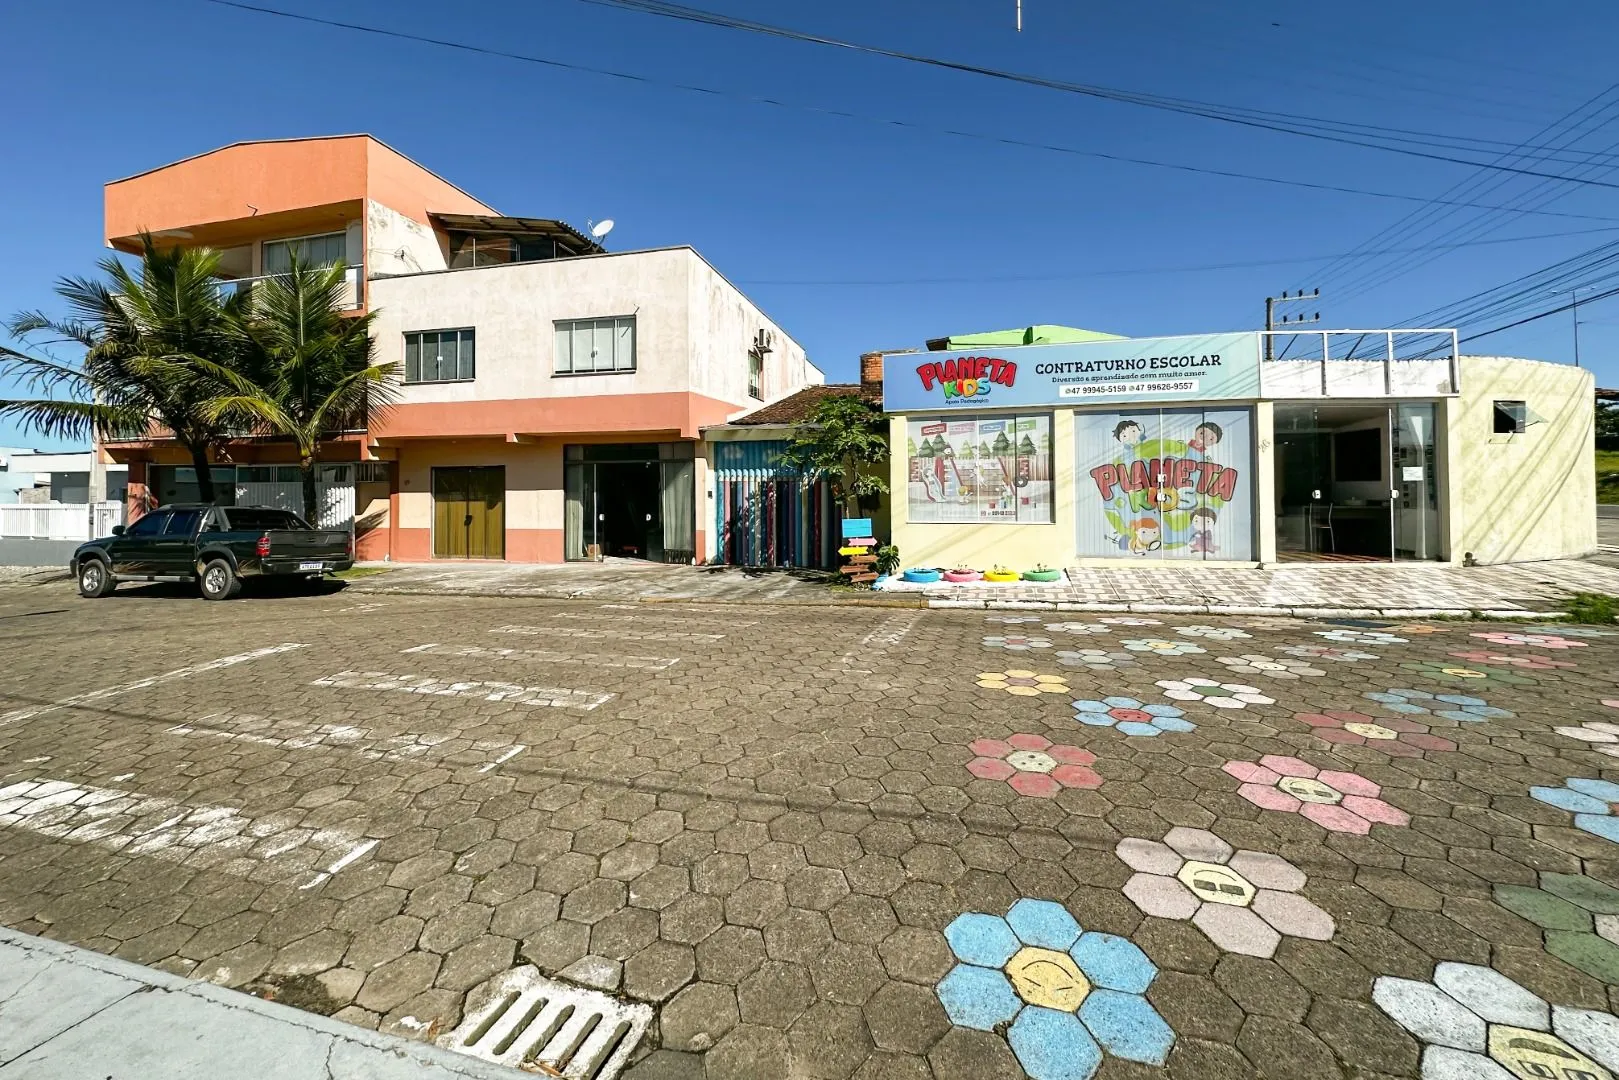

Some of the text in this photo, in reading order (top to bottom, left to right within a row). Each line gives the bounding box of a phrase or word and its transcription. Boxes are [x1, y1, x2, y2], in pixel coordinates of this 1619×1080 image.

[916, 357, 1017, 391] PLANETA
[1035, 354, 1222, 375] CONTRATURNO ESCOLAR
[943, 377, 991, 399] KIDS
[1091, 373, 1139, 383] aprendizado
[1090, 459, 1238, 501] PLANETA
